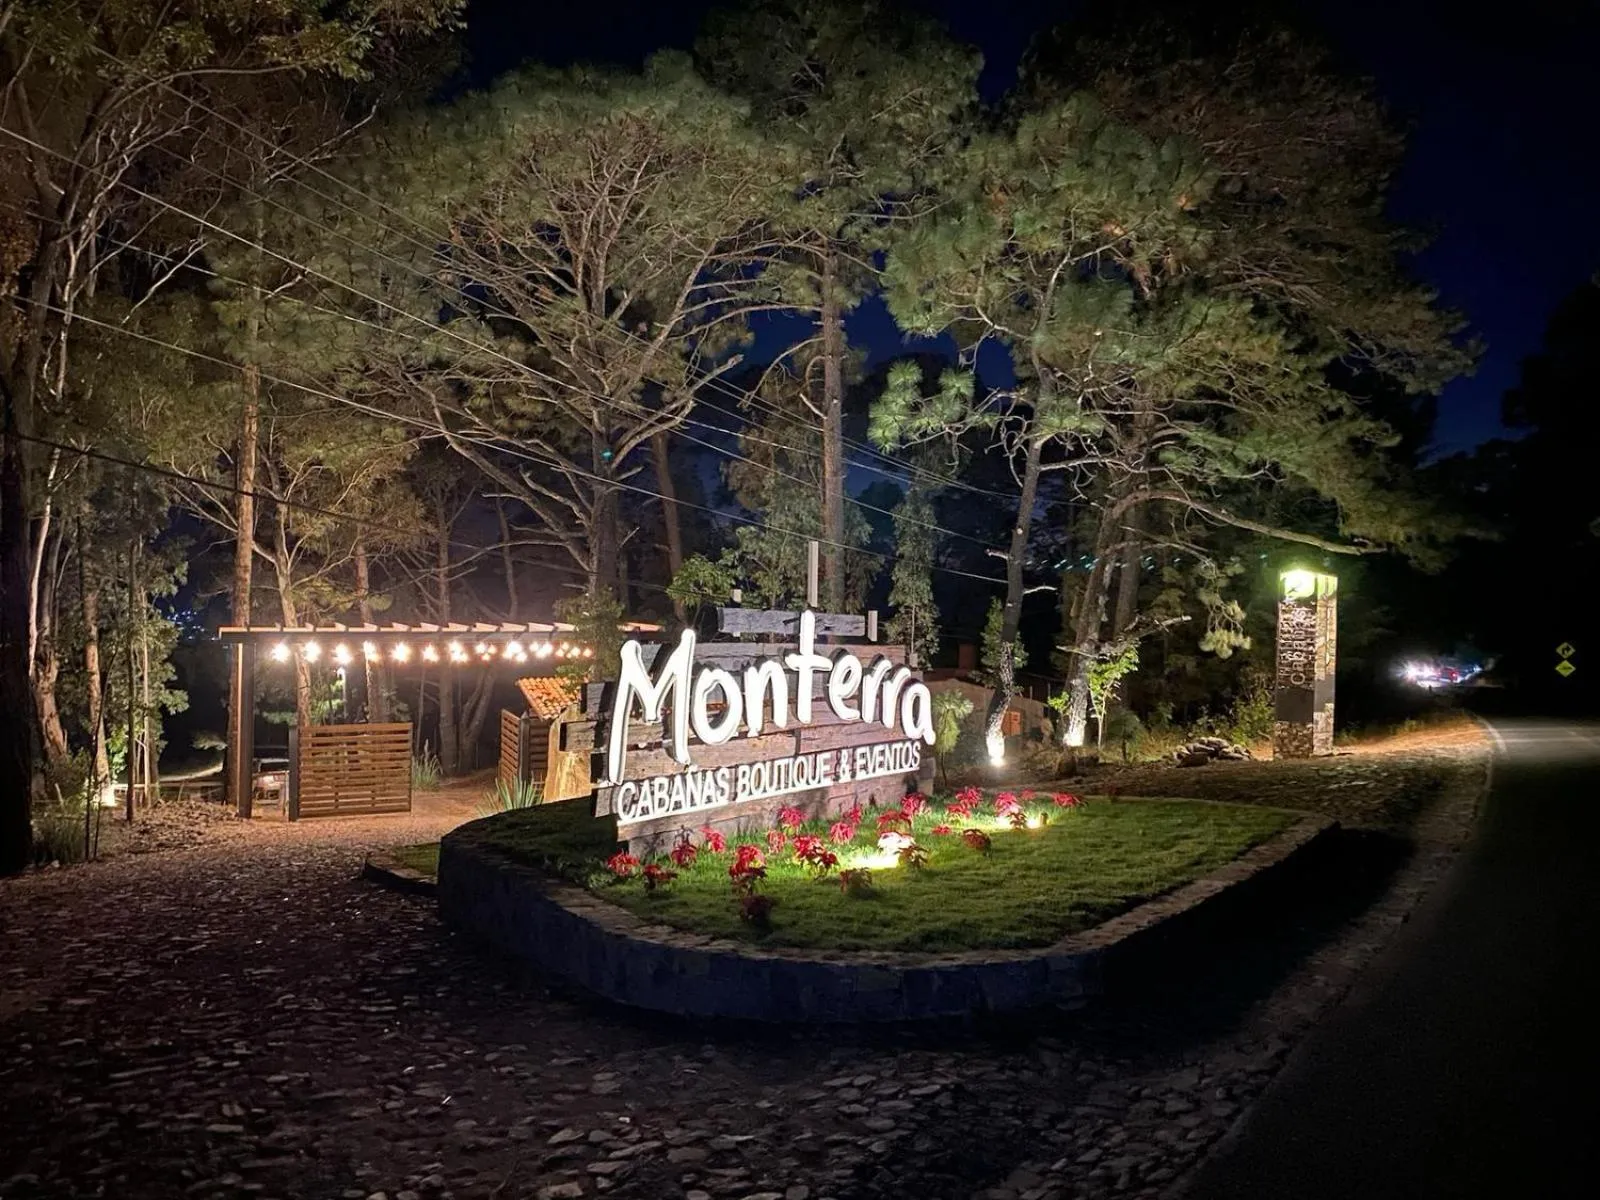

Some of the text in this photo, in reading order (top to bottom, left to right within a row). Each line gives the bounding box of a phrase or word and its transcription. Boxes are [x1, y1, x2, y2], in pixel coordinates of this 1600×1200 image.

[608, 609, 936, 786] Monterra
[617, 741, 921, 822] CABAÑAS BOUTIQUE & EVENTOS
